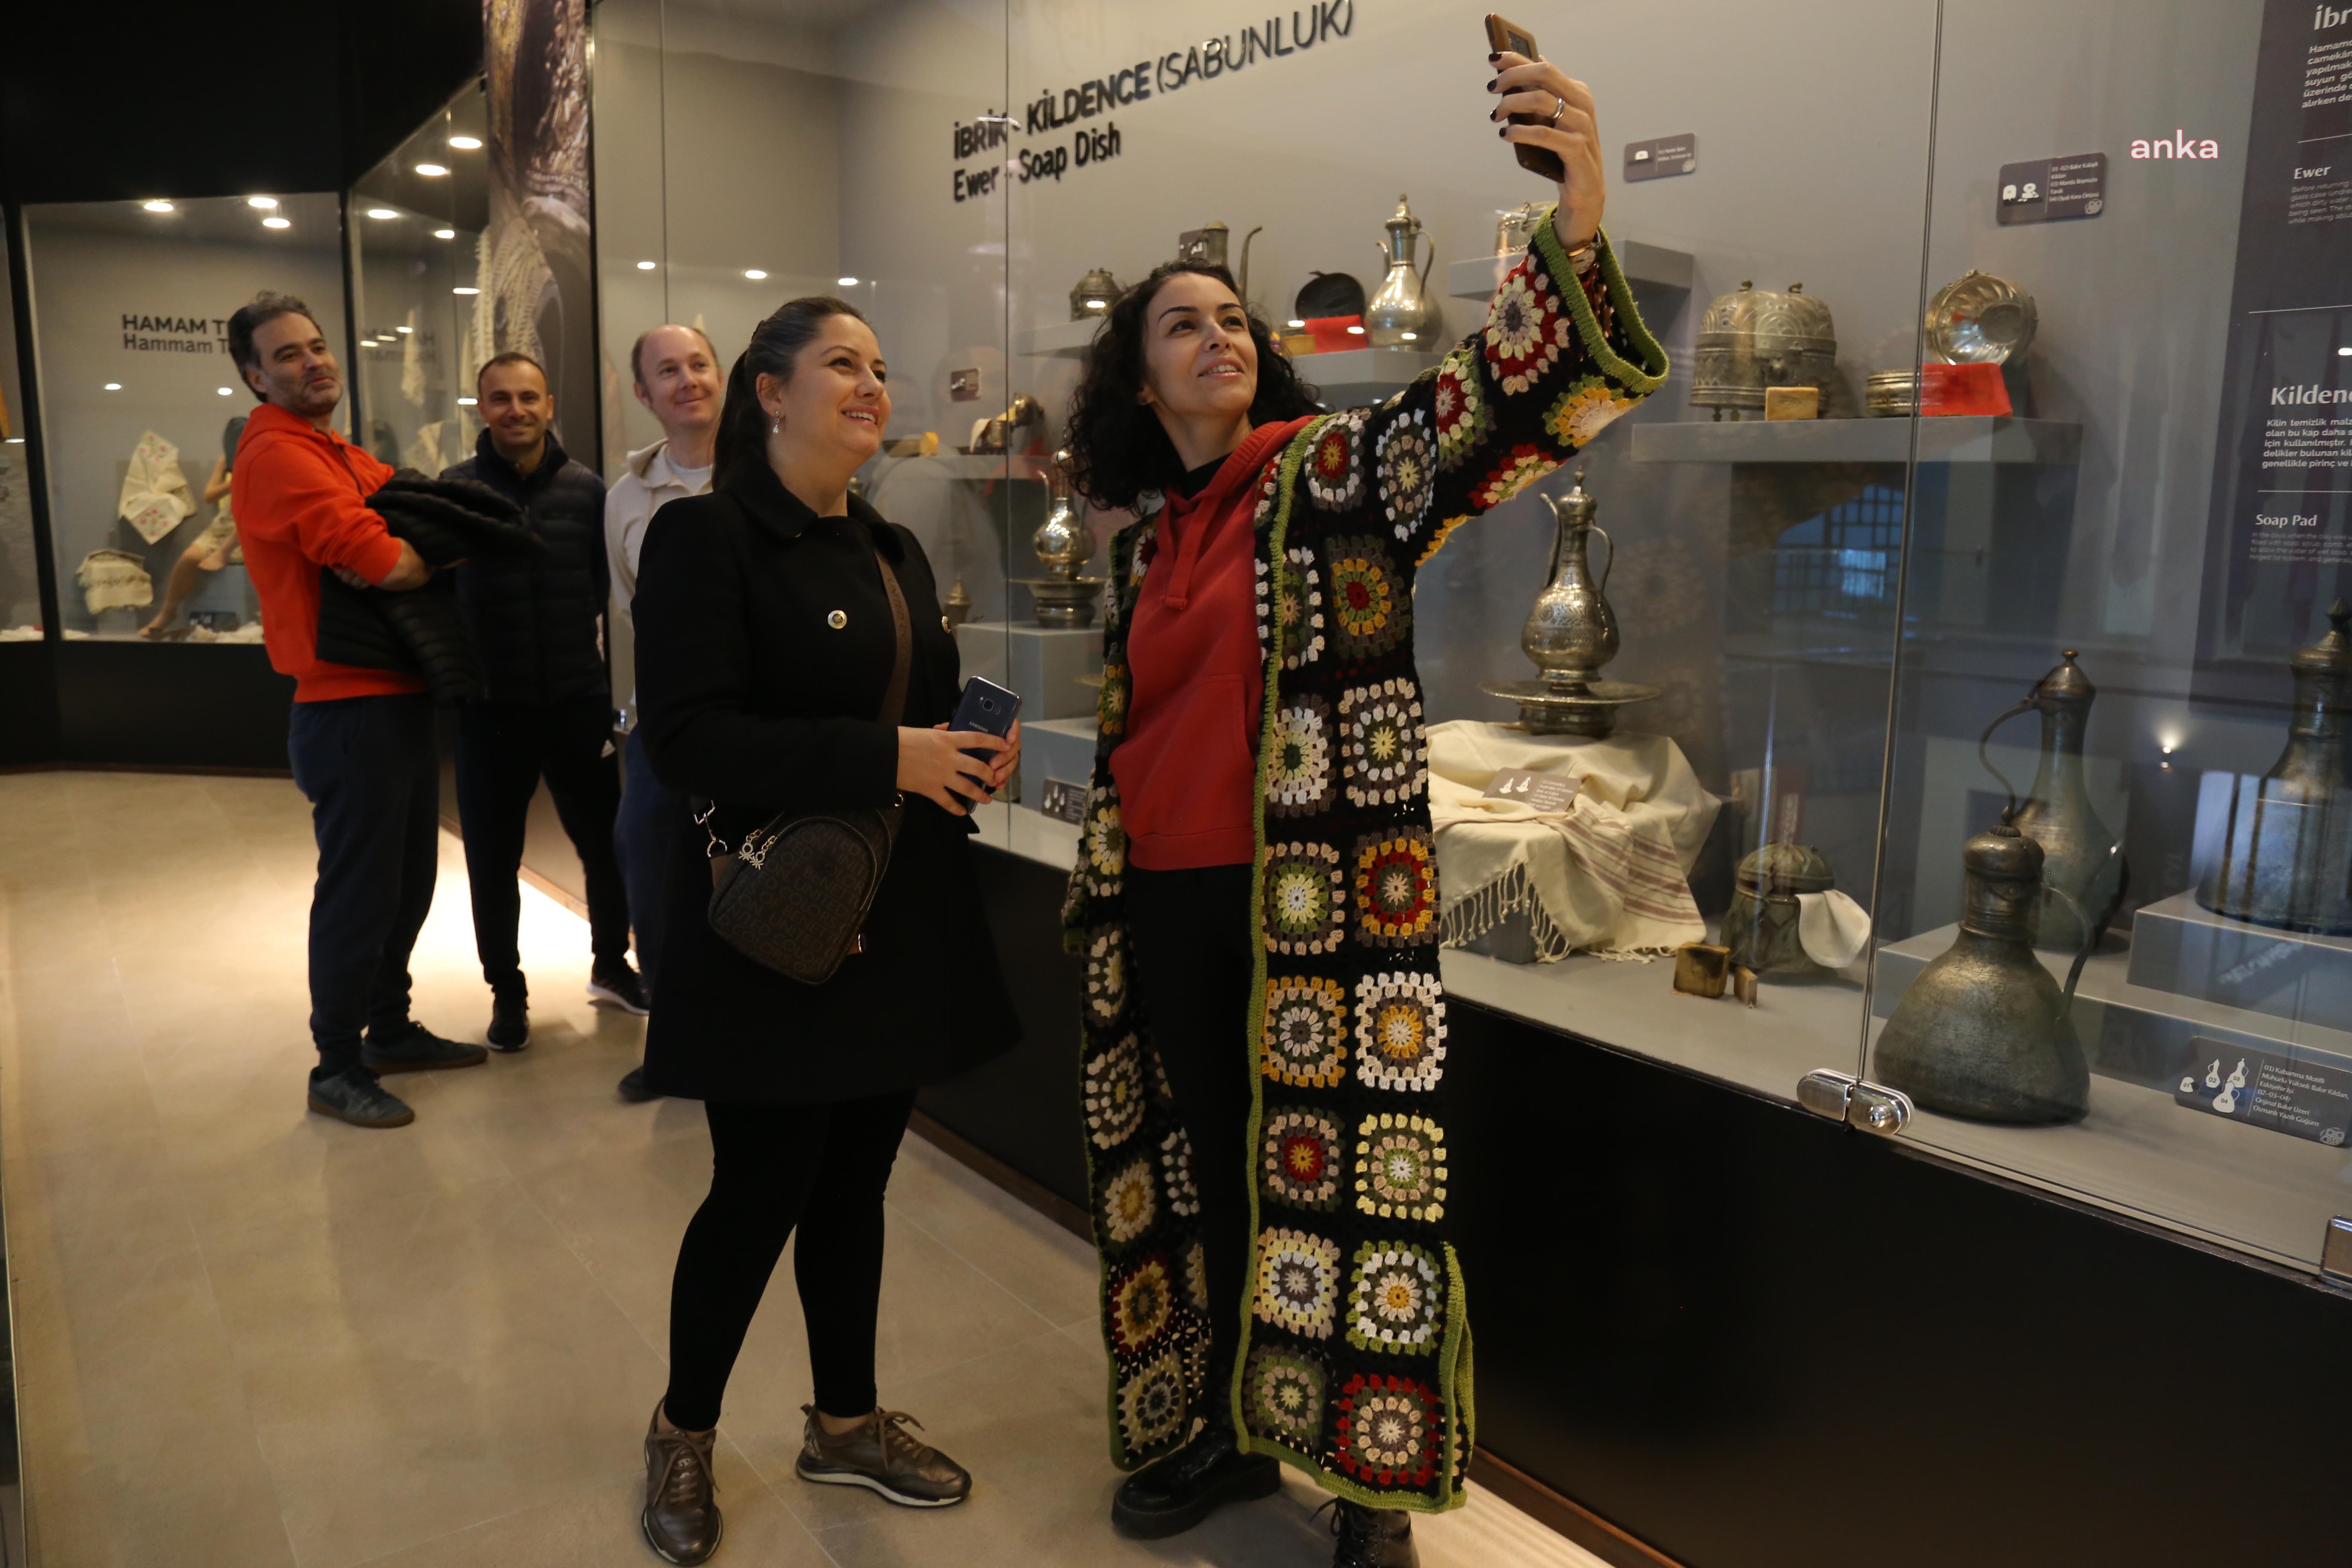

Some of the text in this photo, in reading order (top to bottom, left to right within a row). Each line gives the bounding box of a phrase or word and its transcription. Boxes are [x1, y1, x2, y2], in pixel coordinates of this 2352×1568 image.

[1027, 61, 1151, 136] KİLDENCE
[1157, 0, 1353, 93] (SABUNLUK)
[954, 166, 1000, 203] Ewer
[1019, 148, 1067, 183] Soap
[1075, 122, 1121, 167] Dish
[2294, 166, 2331, 180] Ewer
[122, 314, 207, 334] HAMAM
[123, 333, 213, 354] Hammam
[2255, 514, 2318, 529] Soap Pad
[969, 721, 988, 733] SAMSUNG
